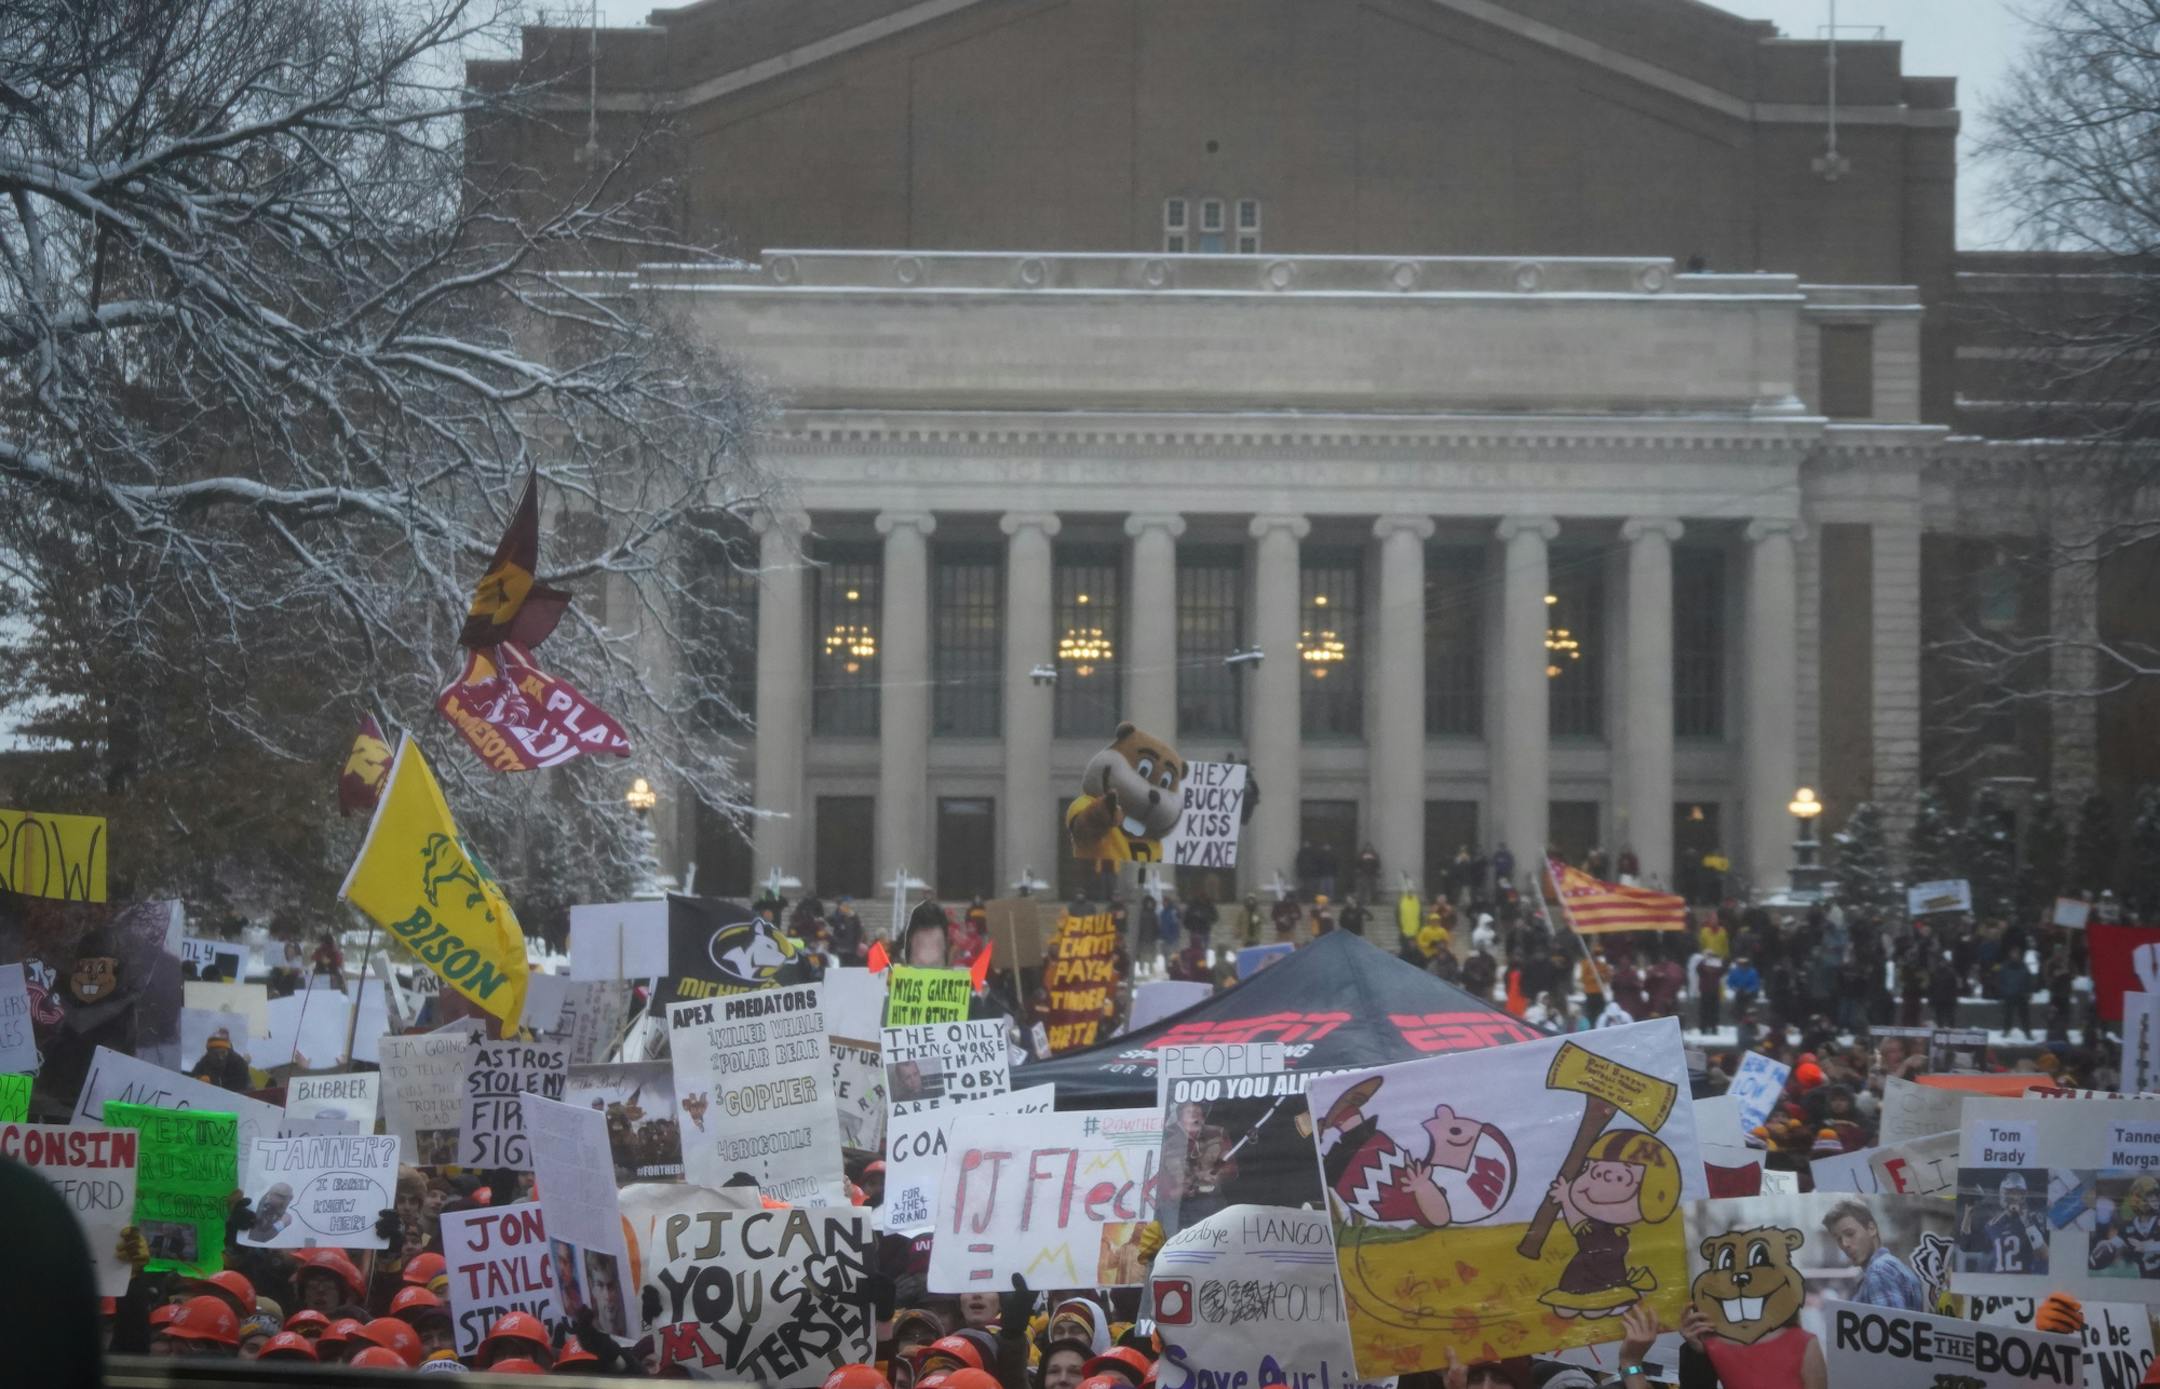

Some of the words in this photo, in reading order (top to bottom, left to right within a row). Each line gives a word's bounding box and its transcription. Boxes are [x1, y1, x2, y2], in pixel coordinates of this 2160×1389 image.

[1193, 763, 1234, 787] HEY
[1184, 788, 1244, 813] BUCKY
[1186, 814, 1232, 837] KISS
[1175, 840, 1203, 865] MY
[1202, 840, 1237, 867] AXE
[391, 905, 509, 999] BISON
[893, 978, 924, 1001] MYLES
[927, 979, 971, 1005] GARRETT
[673, 1003, 715, 1030] APEX
[725, 989, 817, 1021] PREDATORS
[892, 1005, 908, 1024] HIT
[909, 1006, 923, 1025] MY
[715, 1021, 767, 1049] KILLER
[769, 1012, 824, 1041] WHALE
[884, 1028, 936, 1046] THE
[947, 1023, 1006, 1042] ONLY
[1142, 1011, 1352, 1048] ESPN
[390, 1040, 417, 1059] I'M
[424, 1038, 466, 1056] GOING
[474, 1048, 563, 1070] ASTROS
[719, 1046, 770, 1074] POLAR
[775, 1037, 820, 1065] BEAR
[830, 1044, 885, 1070] FUTUR
[887, 1043, 951, 1062] THING
[957, 1040, 1006, 1054] WORSE
[1165, 1042, 1275, 1077] PEOPLE
[389, 1063, 409, 1078] TO
[941, 1053, 996, 1070] THAN
[467, 1069, 539, 1094] STOLE
[943, 1069, 1006, 1090] TOBY
[1227, 1076, 1270, 1100] YOU
[724, 1075, 818, 1117] GOPHER
[893, 1100, 941, 1117] ARE
[471, 1100, 527, 1131] FIR
[727, 1127, 813, 1162] CROCODILE
[1989, 1127, 2022, 1143] Tom
[2114, 1127, 2160, 1144] Tanne
[256, 1136, 396, 1171] TANNER?
[470, 1132, 534, 1166] SIG
[1983, 1148, 2026, 1166] Brady
[2112, 1151, 2160, 1169] Morga
[636, 1163, 685, 1178] #FORTHEB
[316, 1178, 328, 1191] I
[902, 1187, 921, 1201] FOR
[953, 1148, 1013, 1235] PJ
[1019, 1147, 1160, 1232] Fleck
[312, 1198, 356, 1214] KNEW
[891, 1209, 928, 1225] BRAND
[901, 1199, 920, 1214] THE
[329, 1214, 366, 1232] HER!
[465, 1208, 546, 1252] JON
[741, 1209, 862, 1260] CAN
[1994, 1235, 2024, 1272] 12
[458, 1253, 554, 1300] TAYLO
[657, 1265, 763, 1324] YOU
[2107, 1307, 2130, 1346] be
[1837, 1310, 1933, 1362] ROSE
[1934, 1334, 1975, 1358] THE
[1975, 1330, 2082, 1385] BOAT
[1163, 1344, 1249, 1389] Save
